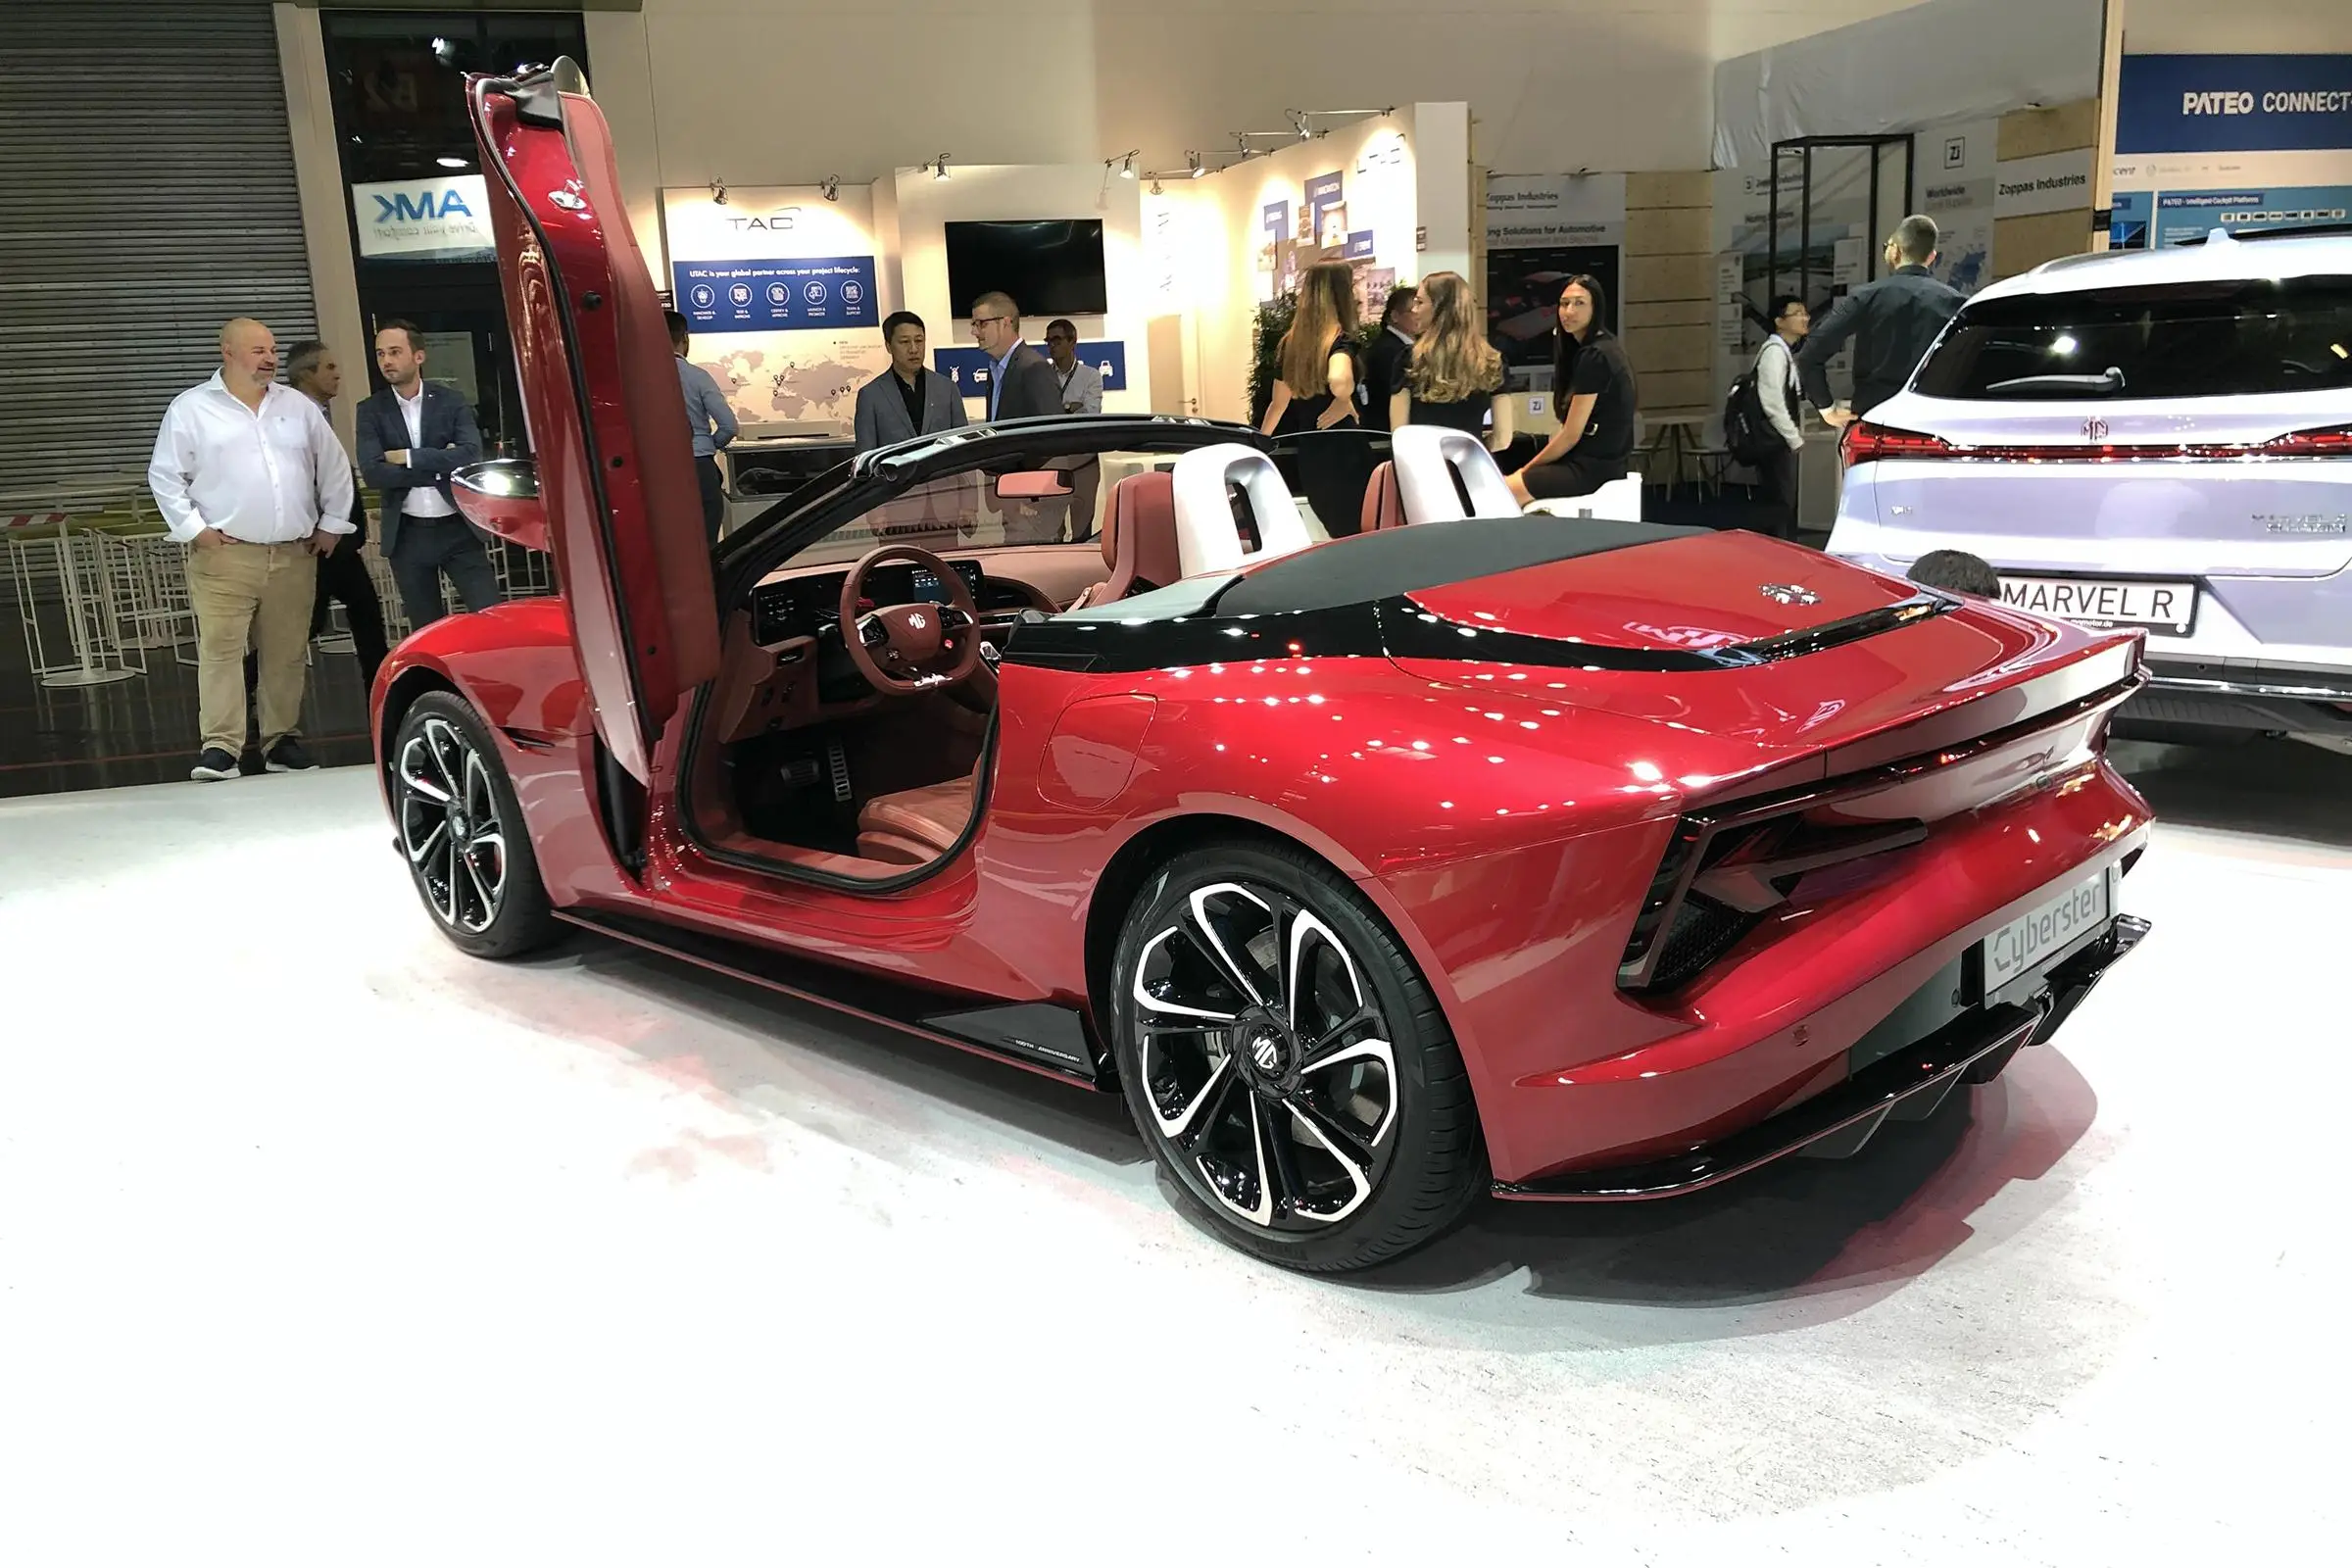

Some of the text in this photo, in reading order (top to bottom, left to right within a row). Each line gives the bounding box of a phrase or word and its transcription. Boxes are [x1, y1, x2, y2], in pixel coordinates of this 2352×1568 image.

[2182, 91, 2352, 115] PATEO CONNECT
[2112, 165, 2135, 175] cent
[1999, 173, 2086, 197] Zoppas Industries
[1558, 225, 1606, 234] Automotive
[731, 269, 752, 277] global
[2003, 582, 2174, 618] MARVEL R
[907, 612, 926, 629] MG
[1993, 884, 2100, 974] Cyberster
[1251, 1036, 1278, 1069] MG
